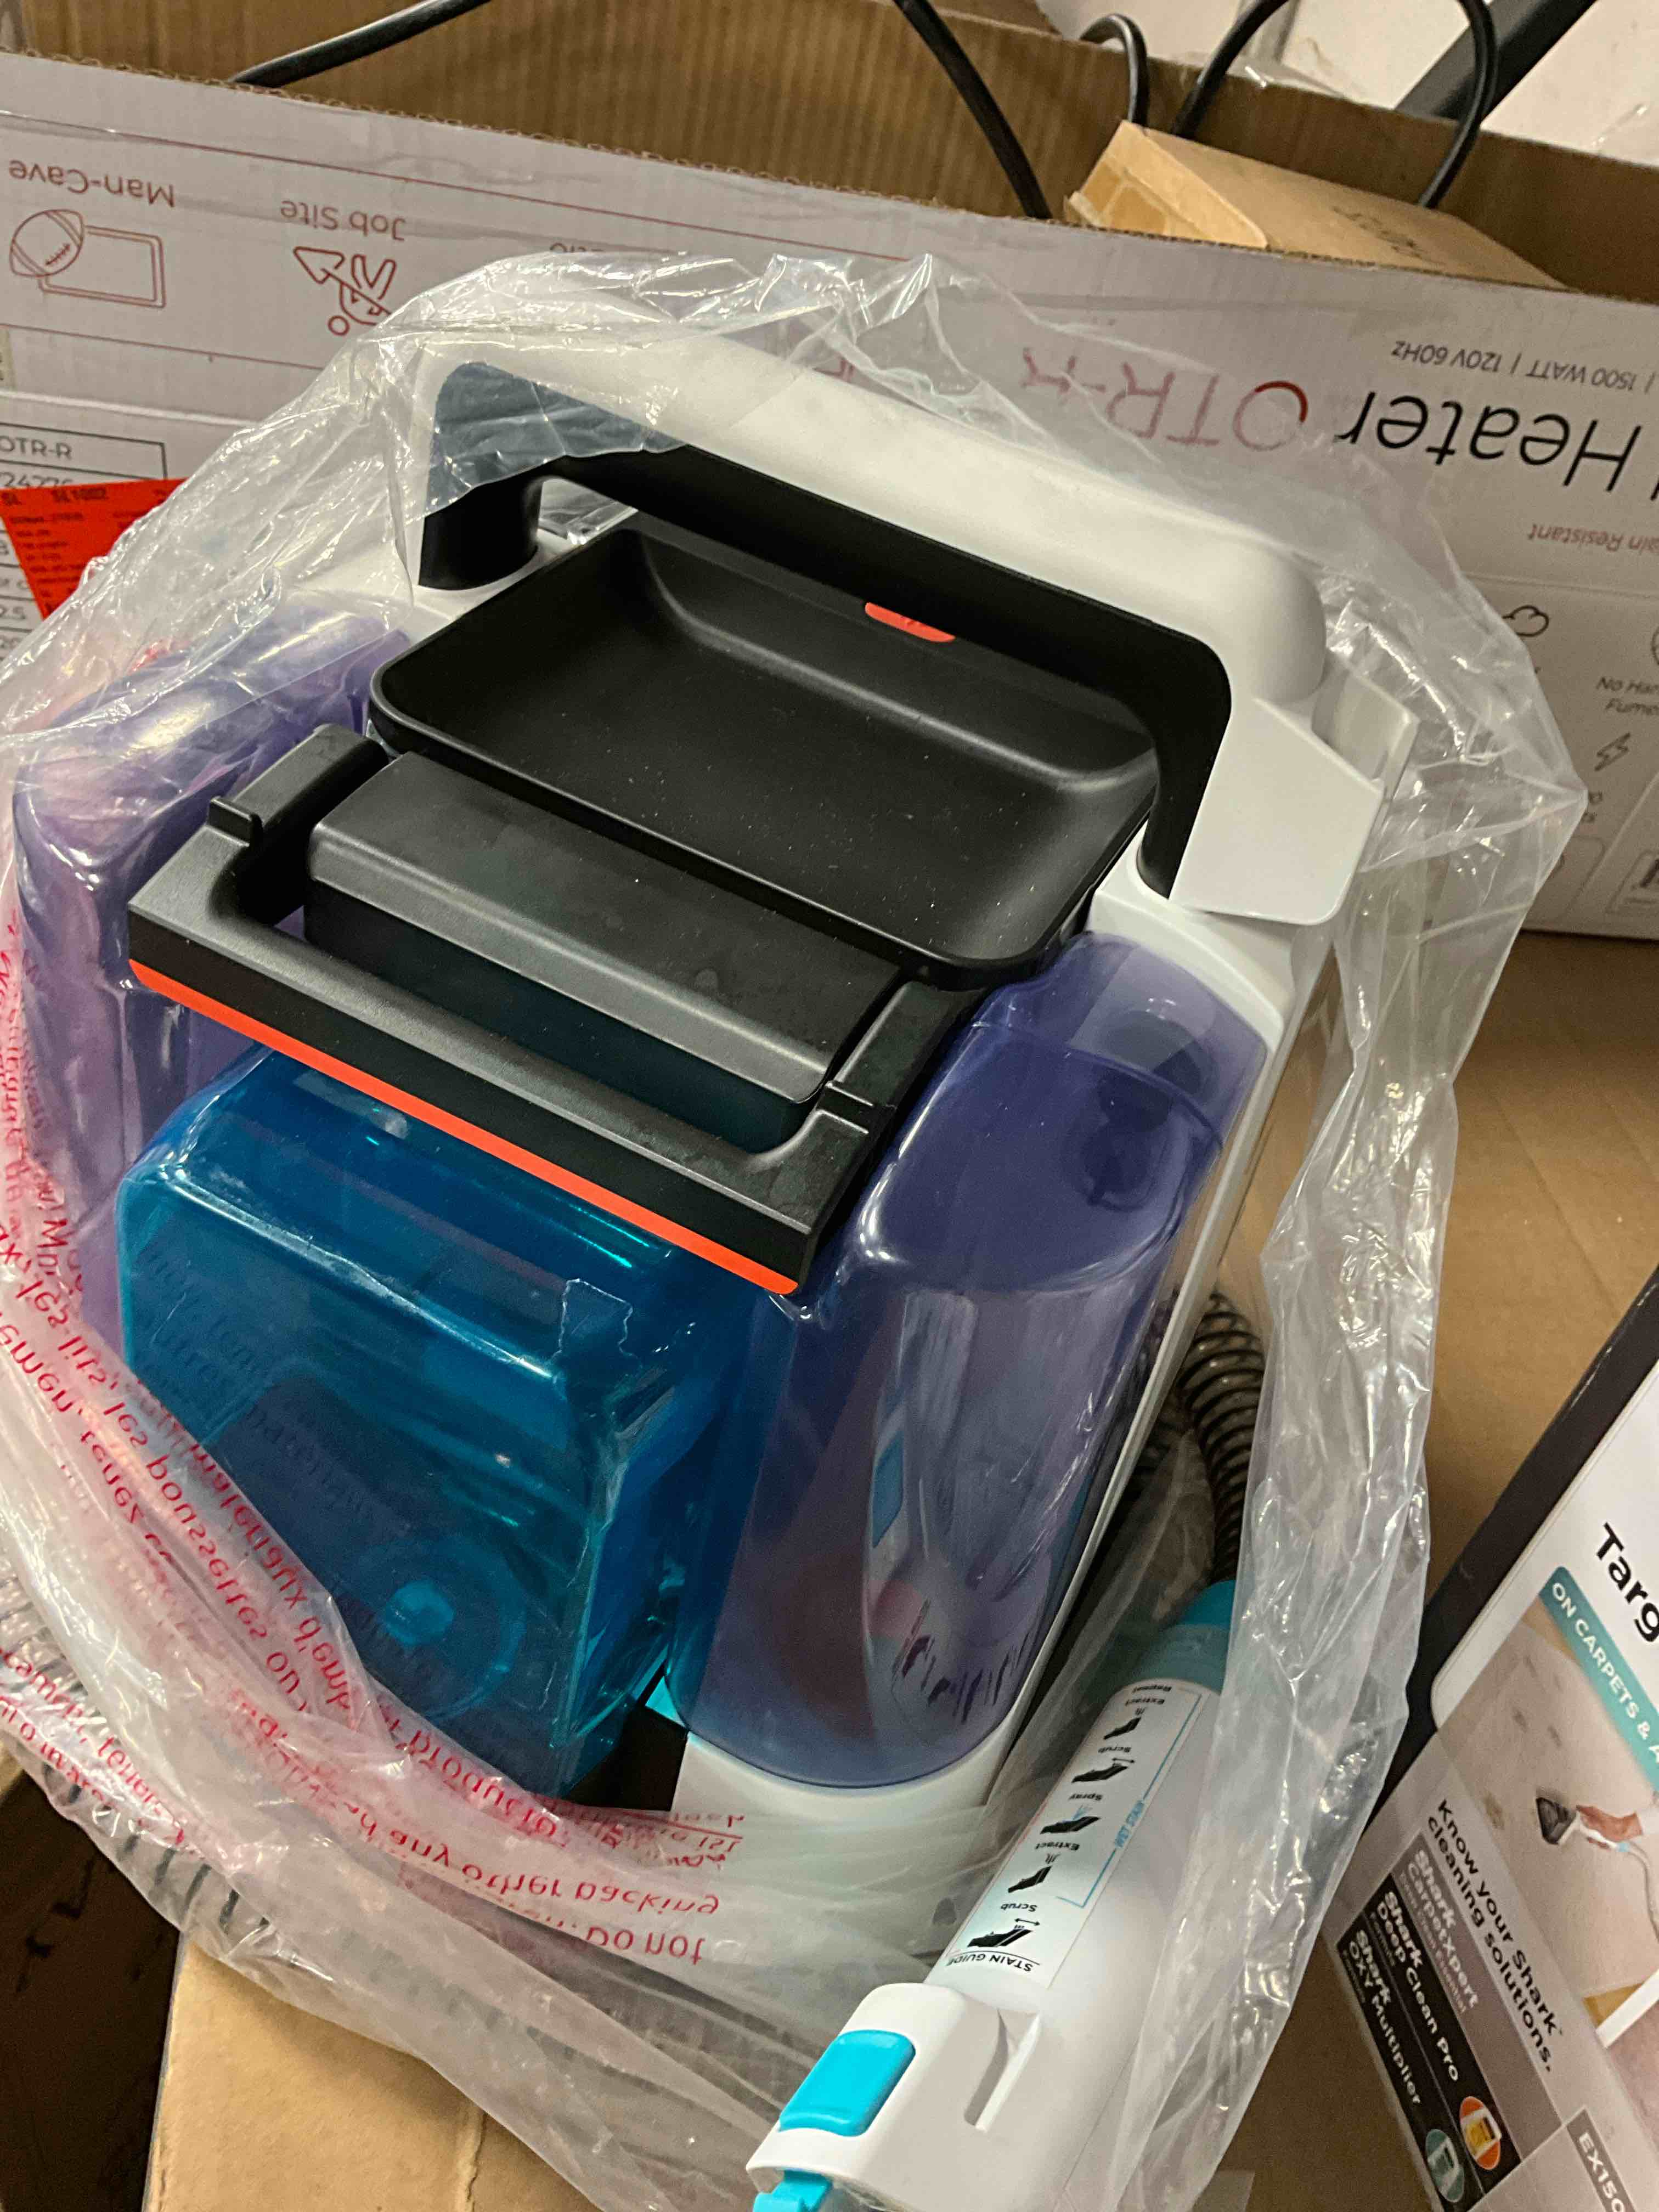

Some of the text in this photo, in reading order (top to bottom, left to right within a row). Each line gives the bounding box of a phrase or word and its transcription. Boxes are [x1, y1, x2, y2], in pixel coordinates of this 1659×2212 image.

[8, 159, 176, 207] Man-Cave
[280, 200, 407, 242] Job Site
[1450, 347, 1502, 373] 120V
[1526, 359, 1586, 384] WATT
[1591, 367, 1637, 391] 1500
[1334, 391, 1641, 492] Heater
[1528, 523, 1623, 552] Resistant
[1552, 1582, 1577, 1619] ON
[1574, 1618, 1640, 1718] CARPETS
[1637, 1720, 1650, 1740] &
[1097, 1746, 1132, 1754] Scrub
[1068, 1792, 1103, 1802] Spray
[1035, 1840, 1080, 1850] Extract
[1417, 1849, 1455, 1928] Shark
[1437, 1799, 1480, 1876] Know
[1480, 1882, 1514, 1943] your
[1000, 1902, 1037, 1912] Scrub
[1384, 1891, 1423, 1970] Shark
[1407, 1862, 1480, 2009] CarpetXpert
[1427, 1816, 1552, 2073] cleaning solutions.
[989, 1954, 1034, 1972] STAIN
[1354, 1928, 1392, 2005] Shark
[1377, 1901, 1406, 1963] Deep
[1404, 1967, 1438, 2033] Clean
[1437, 2036, 1459, 2082] Pro
[1348, 1940, 1374, 1988] OXY
[1372, 1993, 1421, 2106] Multiplier
